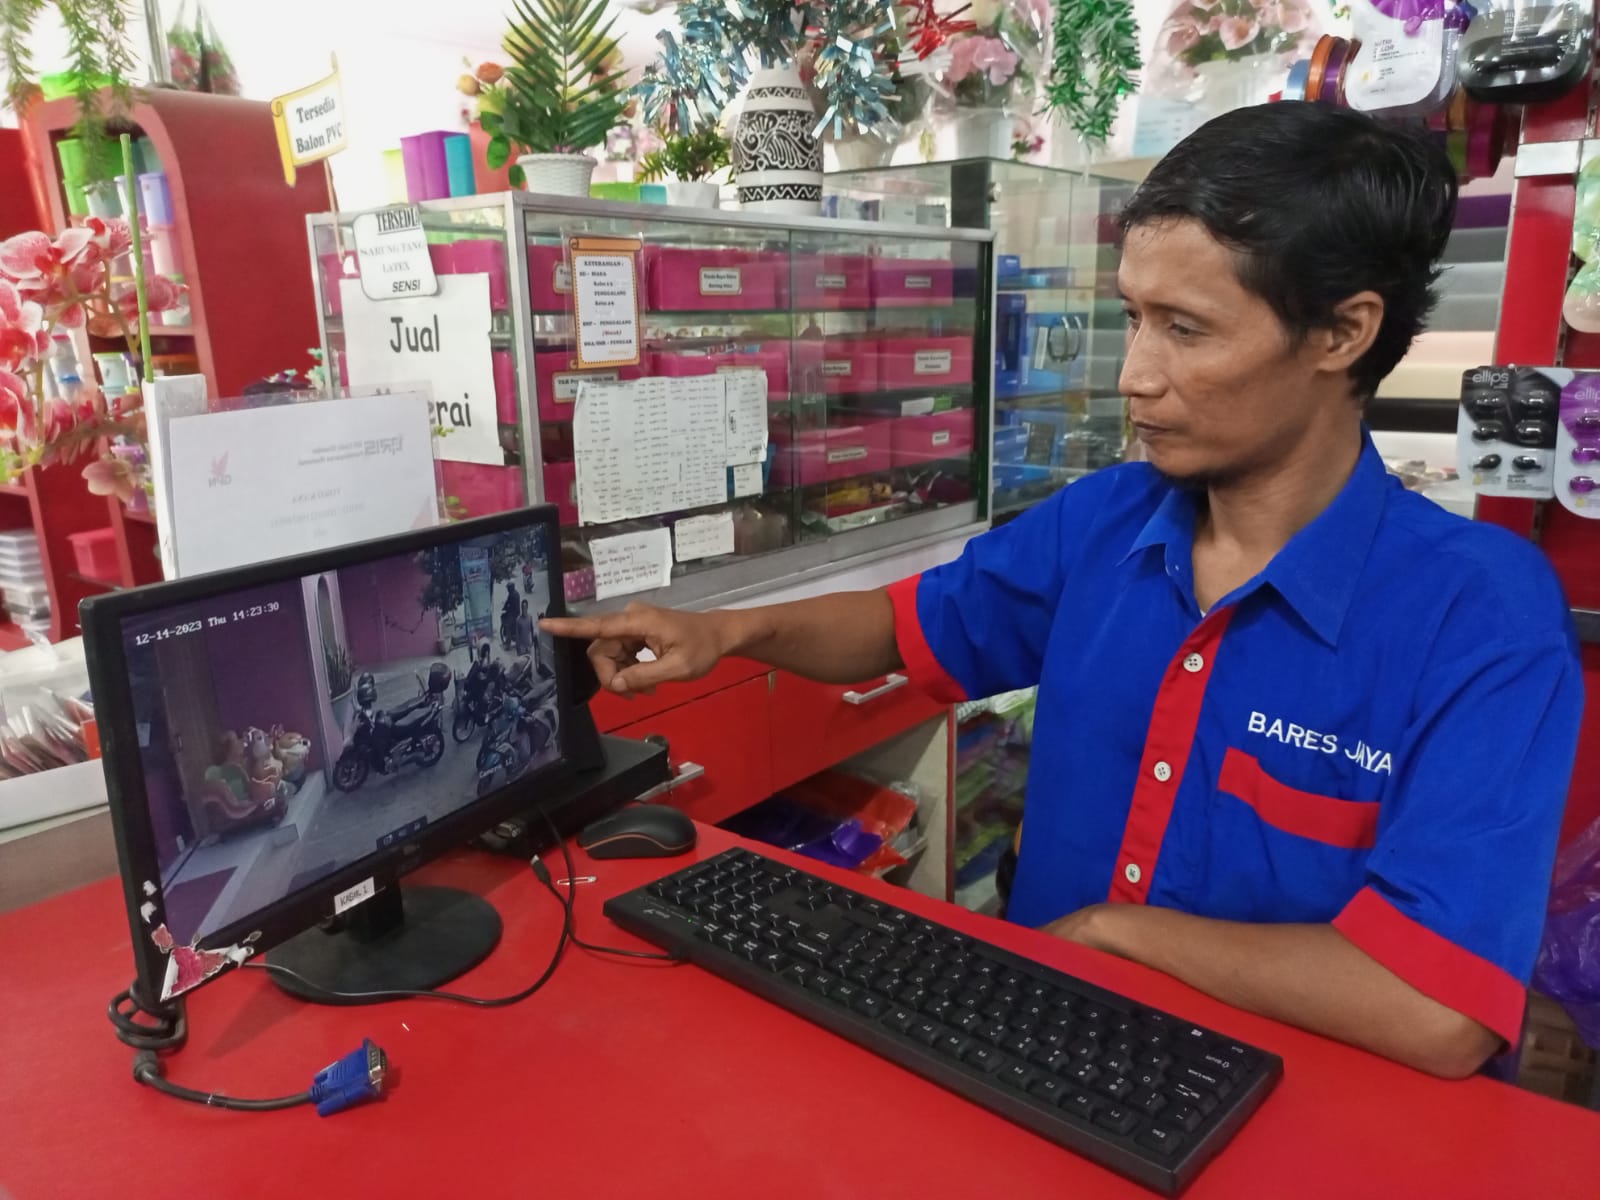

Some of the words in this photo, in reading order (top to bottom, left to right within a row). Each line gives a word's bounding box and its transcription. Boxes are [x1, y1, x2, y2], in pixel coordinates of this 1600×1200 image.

[296, 96, 335, 124] Tersedia
[296, 134, 324, 153] Balon
[325, 122, 342, 145] PVC
[392, 279, 420, 292] SENSI
[390, 314, 440, 353] Jual
[1472, 370, 1509, 386] ellips
[1574, 387, 1600, 404] ellip
[136, 620, 202, 645] 12-14-2023
[208, 616, 227, 627] Thu
[232, 602, 280, 621] 14:23:30
[1248, 711, 1338, 754] BARES
[1344, 740, 1392, 776] JAYA
